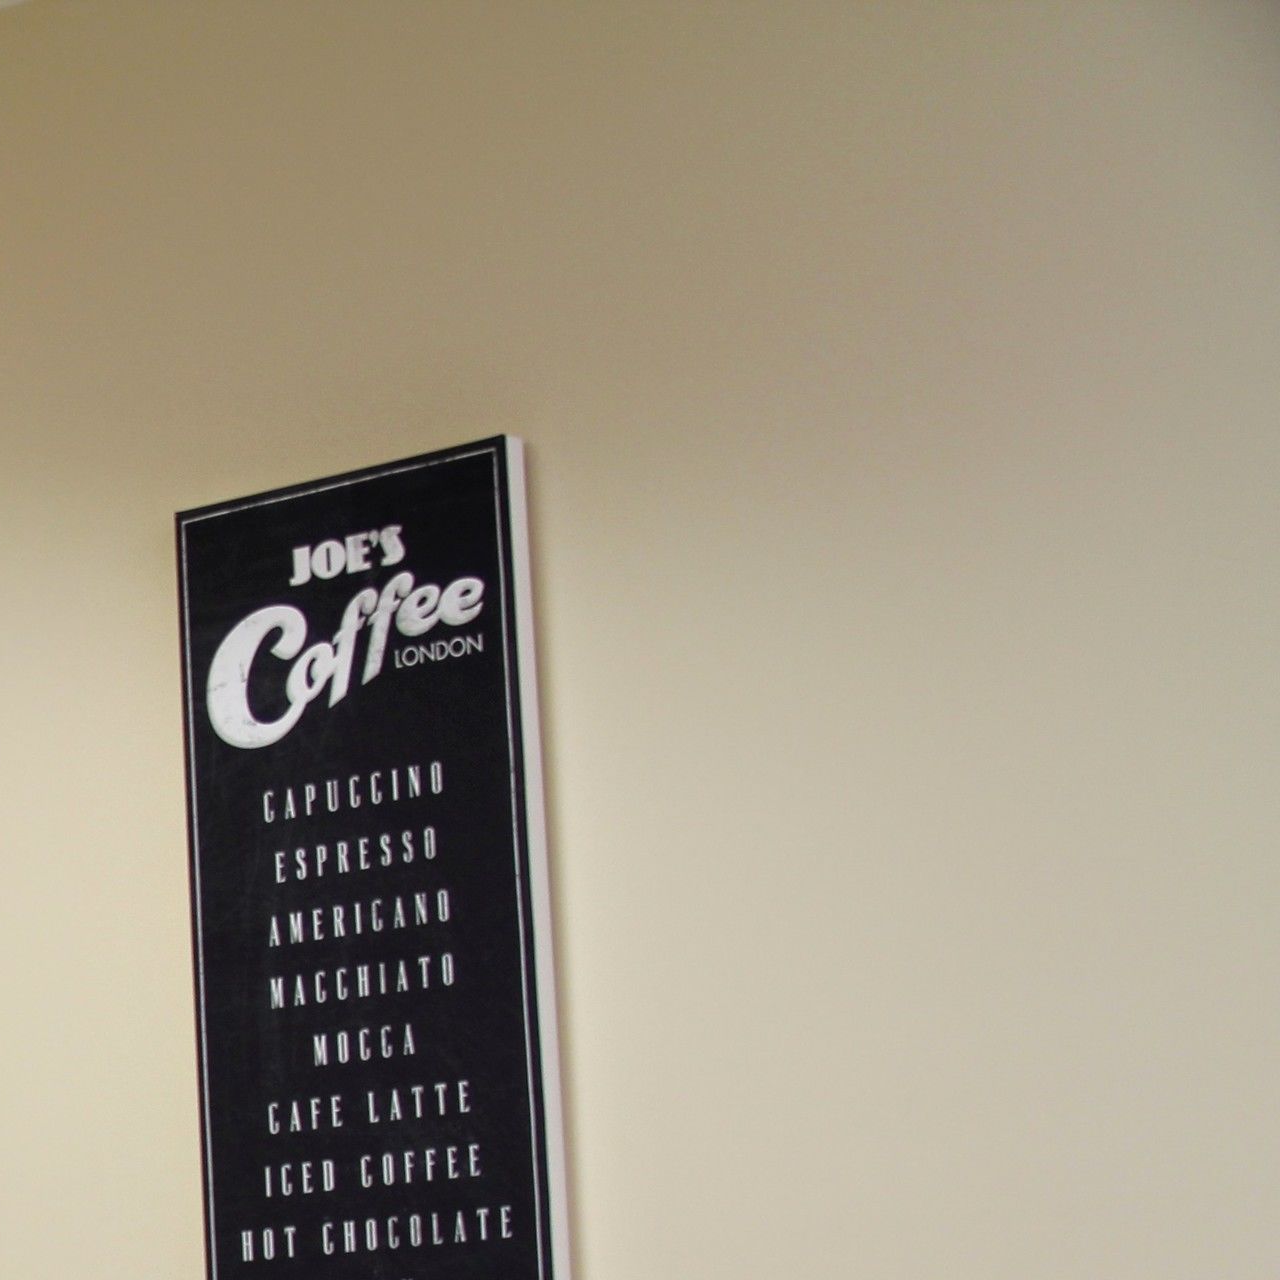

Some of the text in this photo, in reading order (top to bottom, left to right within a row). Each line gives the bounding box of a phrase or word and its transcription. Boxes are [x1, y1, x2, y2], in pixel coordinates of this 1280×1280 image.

[289, 525, 405, 586] JOE'S
[206, 571, 485, 749] Coffee
[395, 634, 483, 668] LONDON
[263, 761, 442, 823] CAPUCCINO
[275, 827, 436, 883] ESPRESSO
[269, 889, 449, 947] AMERICANO
[270, 953, 454, 1009] MACCHIATO
[313, 1024, 415, 1066] MOCCA
[268, 1080, 470, 1134] CAFE LATTE
[265, 1144, 480, 1197] ICED COFFEE
[241, 1206, 512, 1262] HOT CHOCOLATE
